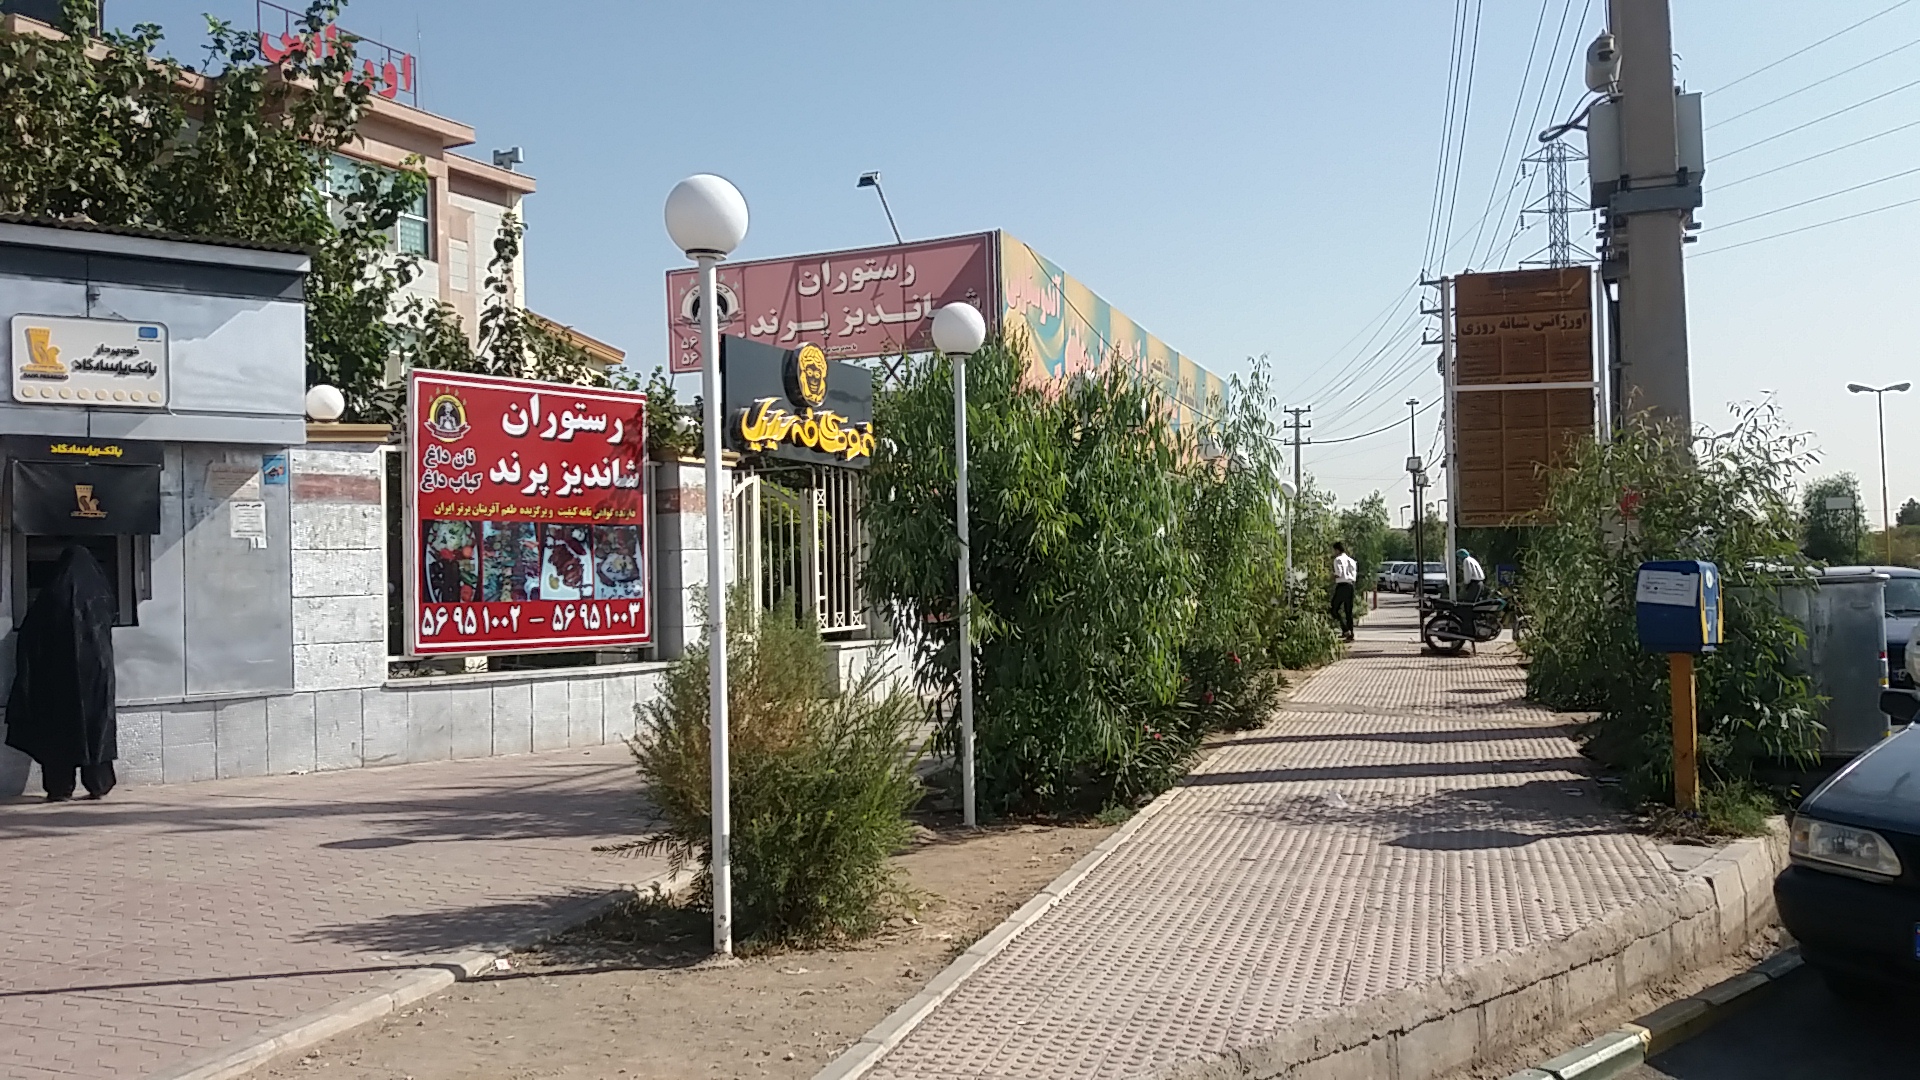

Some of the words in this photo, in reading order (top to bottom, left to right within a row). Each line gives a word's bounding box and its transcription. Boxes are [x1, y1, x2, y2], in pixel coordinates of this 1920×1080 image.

[261, 23, 412, 99] اورانس
[798, 259, 916, 296] رستوران
[750, 307, 830, 342] پرند
[1461, 322, 1496, 335] روزی
[1499, 316, 1530, 331] شبانه
[1533, 312, 1587, 331] اورژانس
[74, 358, 130, 375] پاسارگاد
[129, 361, 157, 376] بانک
[502, 393, 624, 444] رستوران
[50, 444, 99, 456] پاسارگاد
[98, 445, 123, 457] بانک
[423, 444, 451, 468] داغ
[452, 447, 476, 470] نان
[420, 469, 447, 492] داغ
[489, 451, 550, 496] پرند
[555, 457, 640, 496] شاندیز
[448, 471, 483, 494] کباب
[433, 502, 455, 515] ایران
[455, 502, 472, 516] برتر
[501, 503, 518, 516] طعم
[519, 505, 548, 518] برگزیده
[557, 506, 578, 518] کیفیت
[578, 506, 592, 517] نامه
